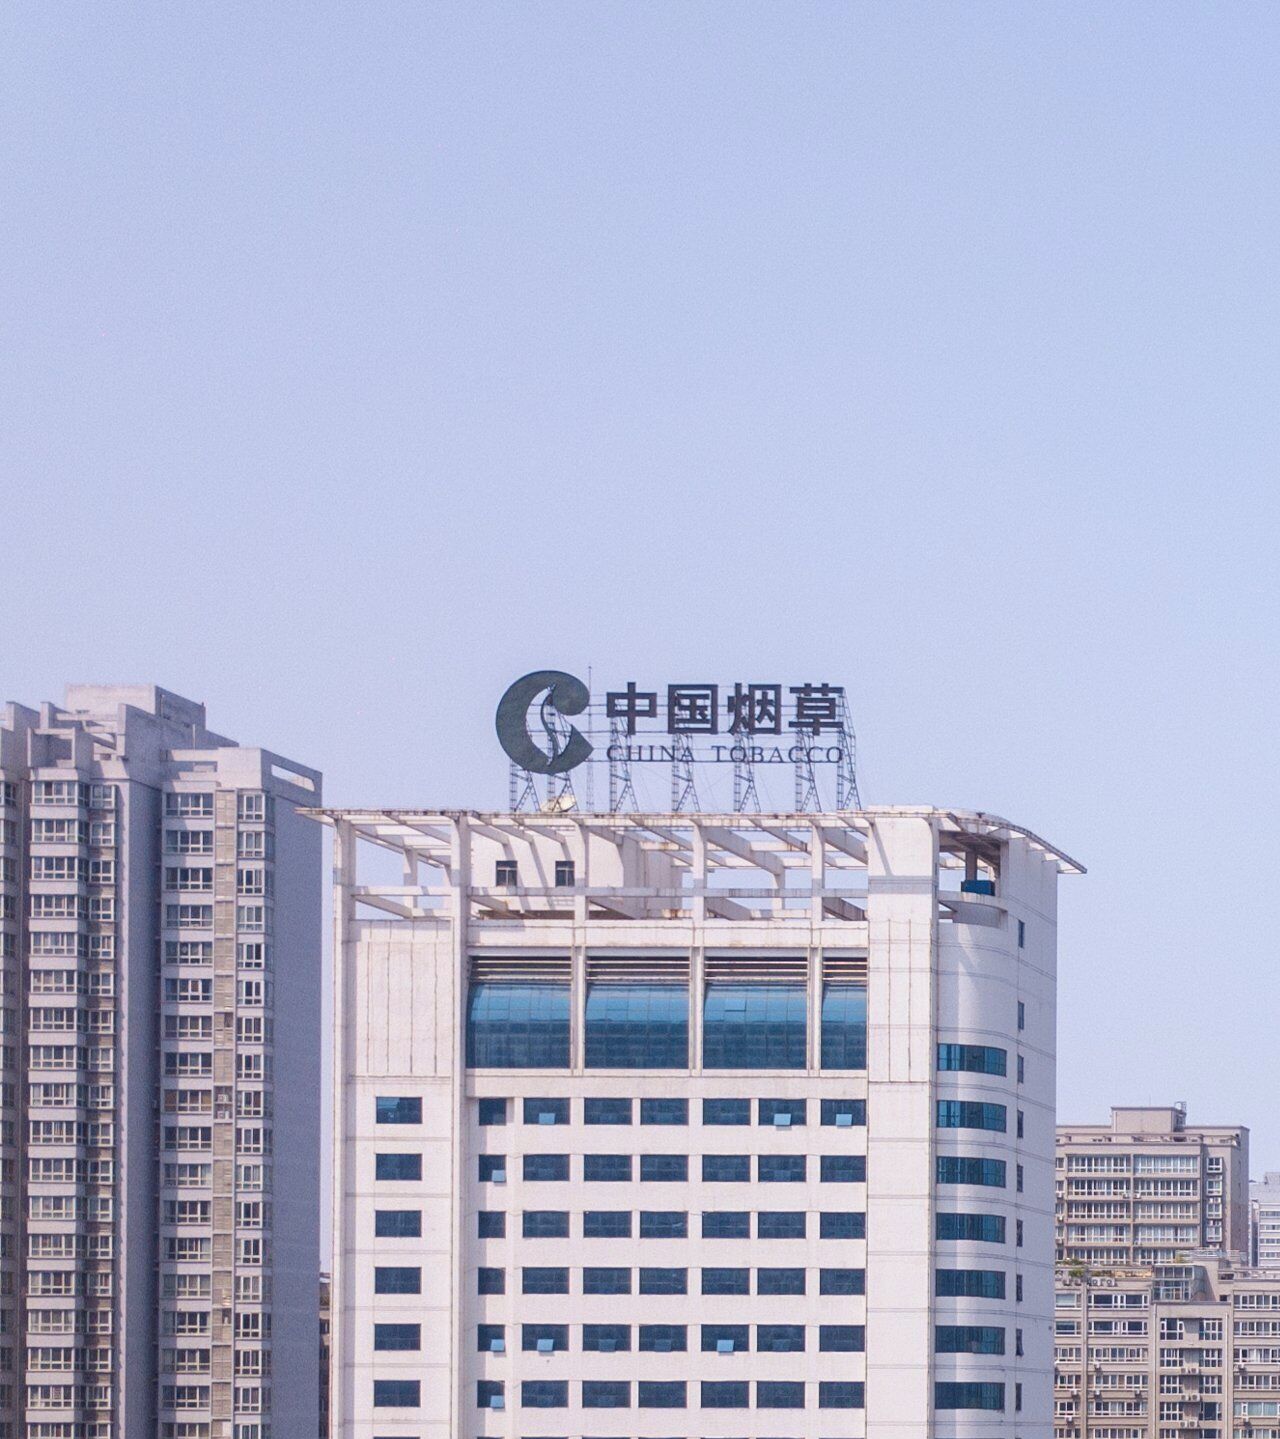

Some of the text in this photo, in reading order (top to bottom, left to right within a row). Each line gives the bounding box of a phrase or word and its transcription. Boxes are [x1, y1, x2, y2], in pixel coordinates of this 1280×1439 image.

[605, 681, 845, 736] 中国烟草
[606, 745, 845, 764] CHINA TOBACCO
